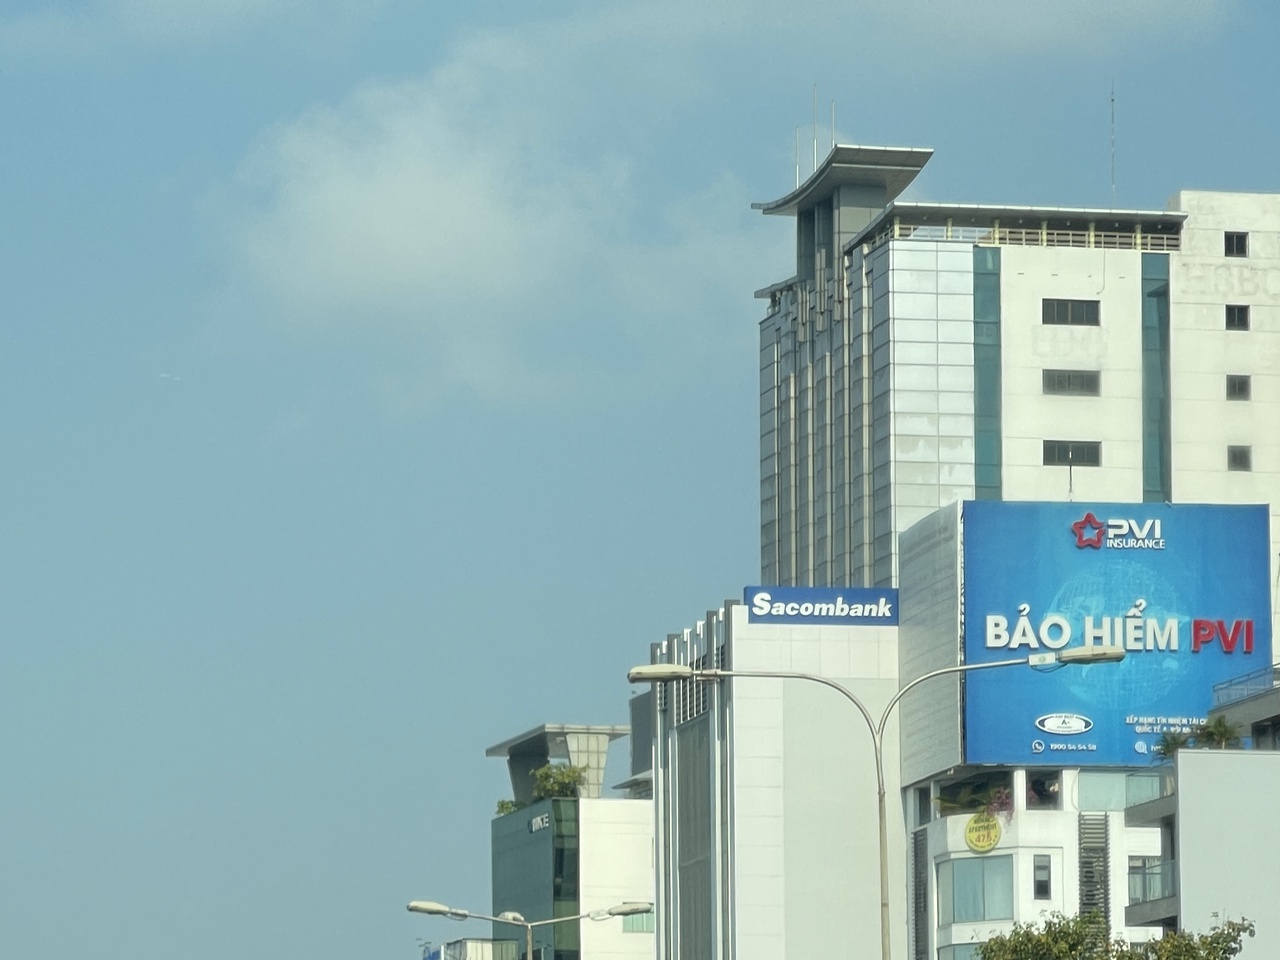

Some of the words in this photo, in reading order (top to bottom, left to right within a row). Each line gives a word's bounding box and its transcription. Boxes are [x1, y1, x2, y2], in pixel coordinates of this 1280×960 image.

[1107, 519, 1161, 538] PVI
[1106, 539, 1166, 549] INSURANCE
[752, 592, 893, 618] Sacombank
[985, 604, 1072, 651] BẢO
[1084, 599, 1179, 651] HIỂM
[1191, 619, 1255, 654] PVI
